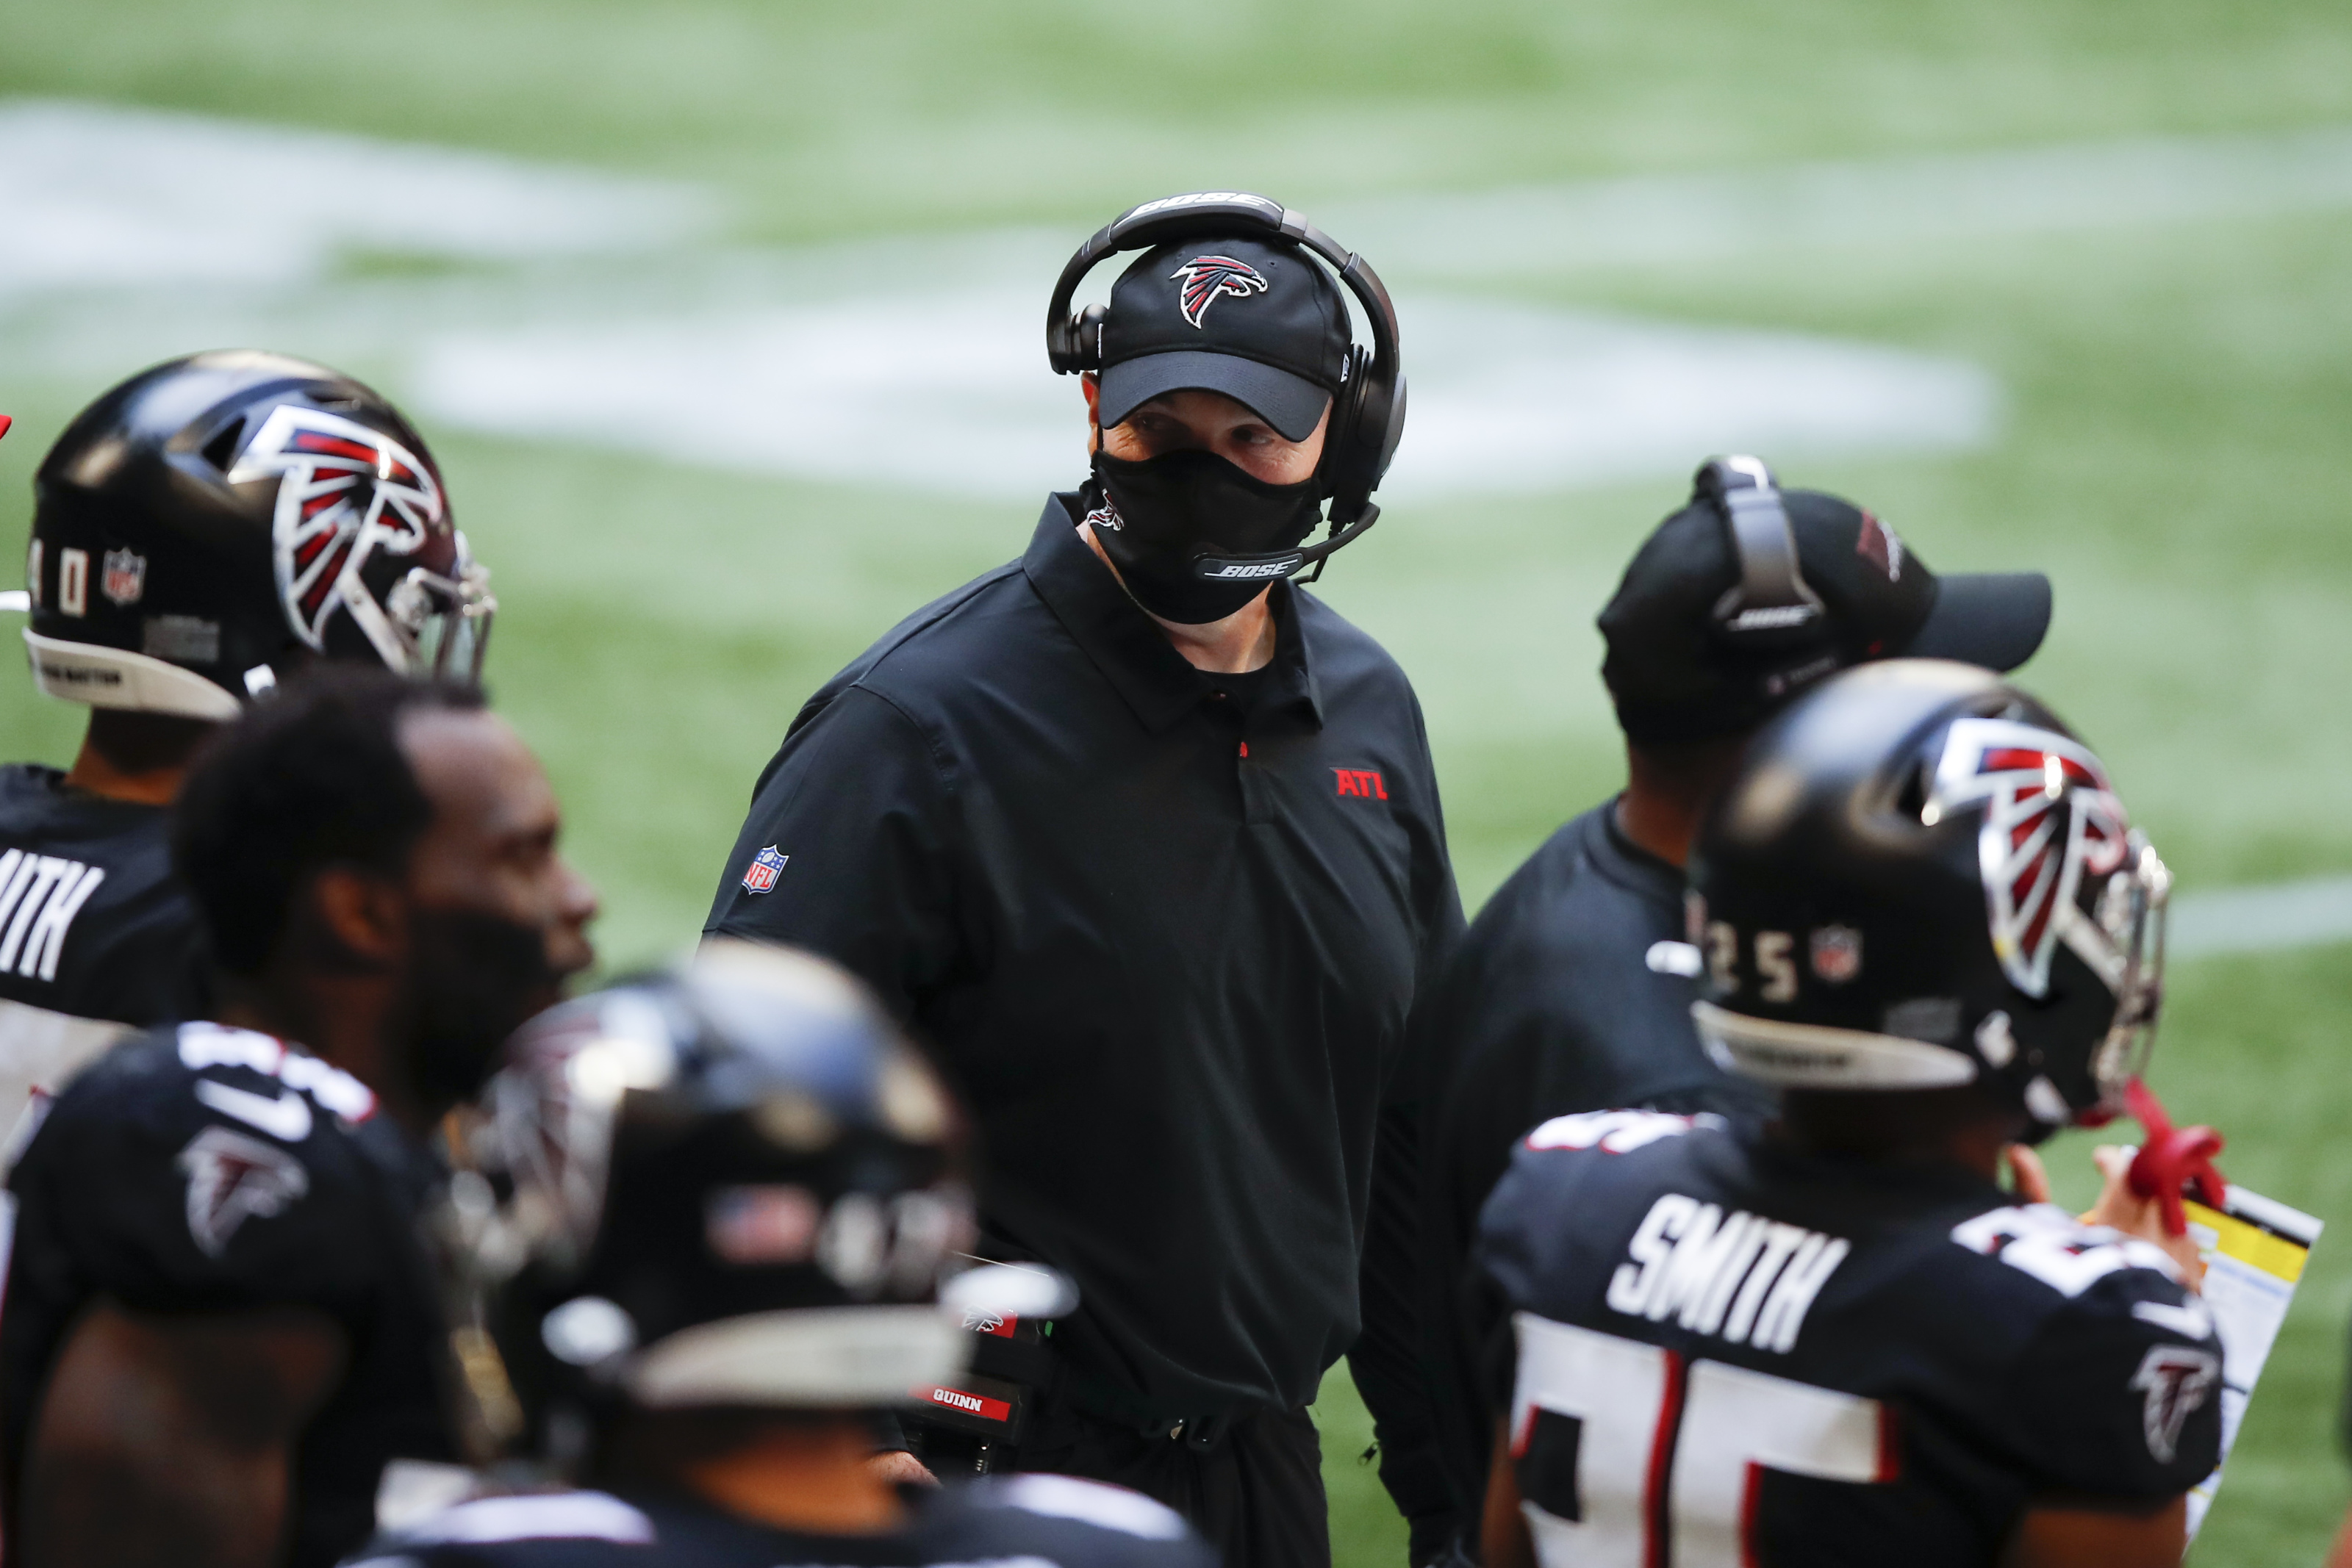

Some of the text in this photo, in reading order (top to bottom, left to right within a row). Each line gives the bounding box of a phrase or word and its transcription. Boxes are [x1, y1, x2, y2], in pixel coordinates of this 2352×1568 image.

[1117, 193, 1282, 223] BOSE
[1207, 559, 1298, 578] BOSE
[1333, 769, 1388, 801] ATL
[744, 861, 772, 888] NFL
[1606, 1193, 1851, 1353] SMITH
[933, 1388, 983, 1412] QUINN
